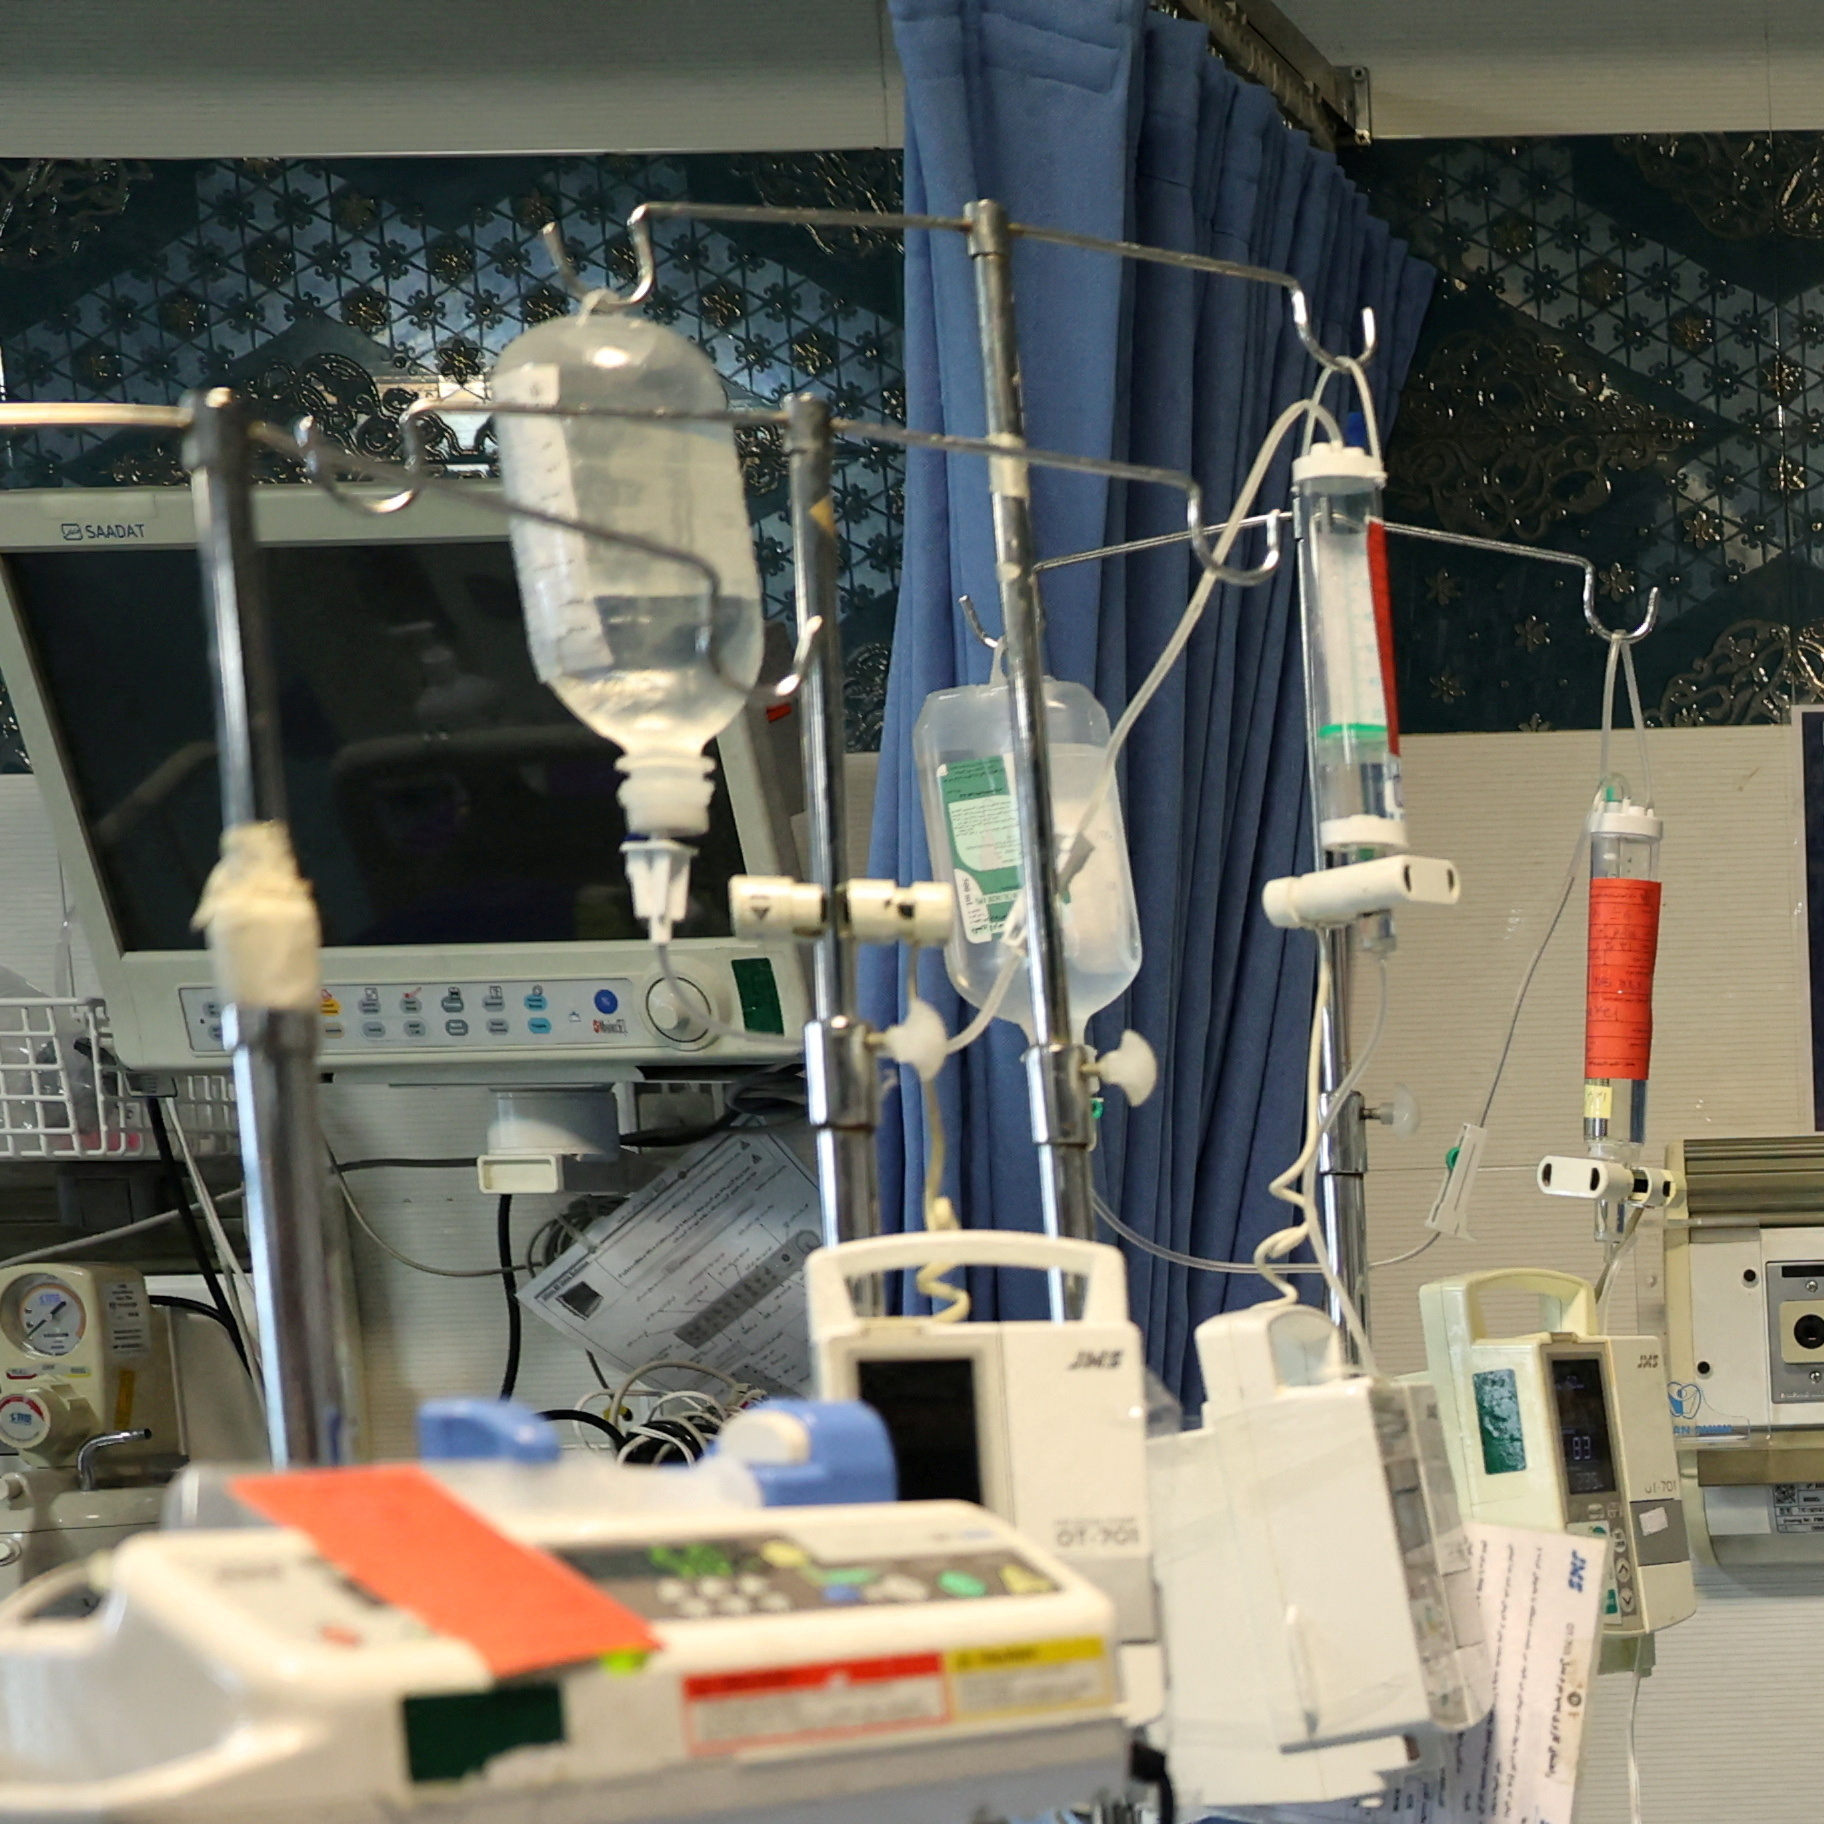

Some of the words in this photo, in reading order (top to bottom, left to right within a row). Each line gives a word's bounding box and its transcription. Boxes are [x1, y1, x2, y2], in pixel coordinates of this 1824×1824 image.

[85, 524, 144, 539] SAADAT
[1066, 1350, 1124, 1370] JMS
[1637, 1354, 1660, 1369] JMS
[1572, 1435, 1592, 1460] 83
[1568, 1549, 1587, 1593] JMS
